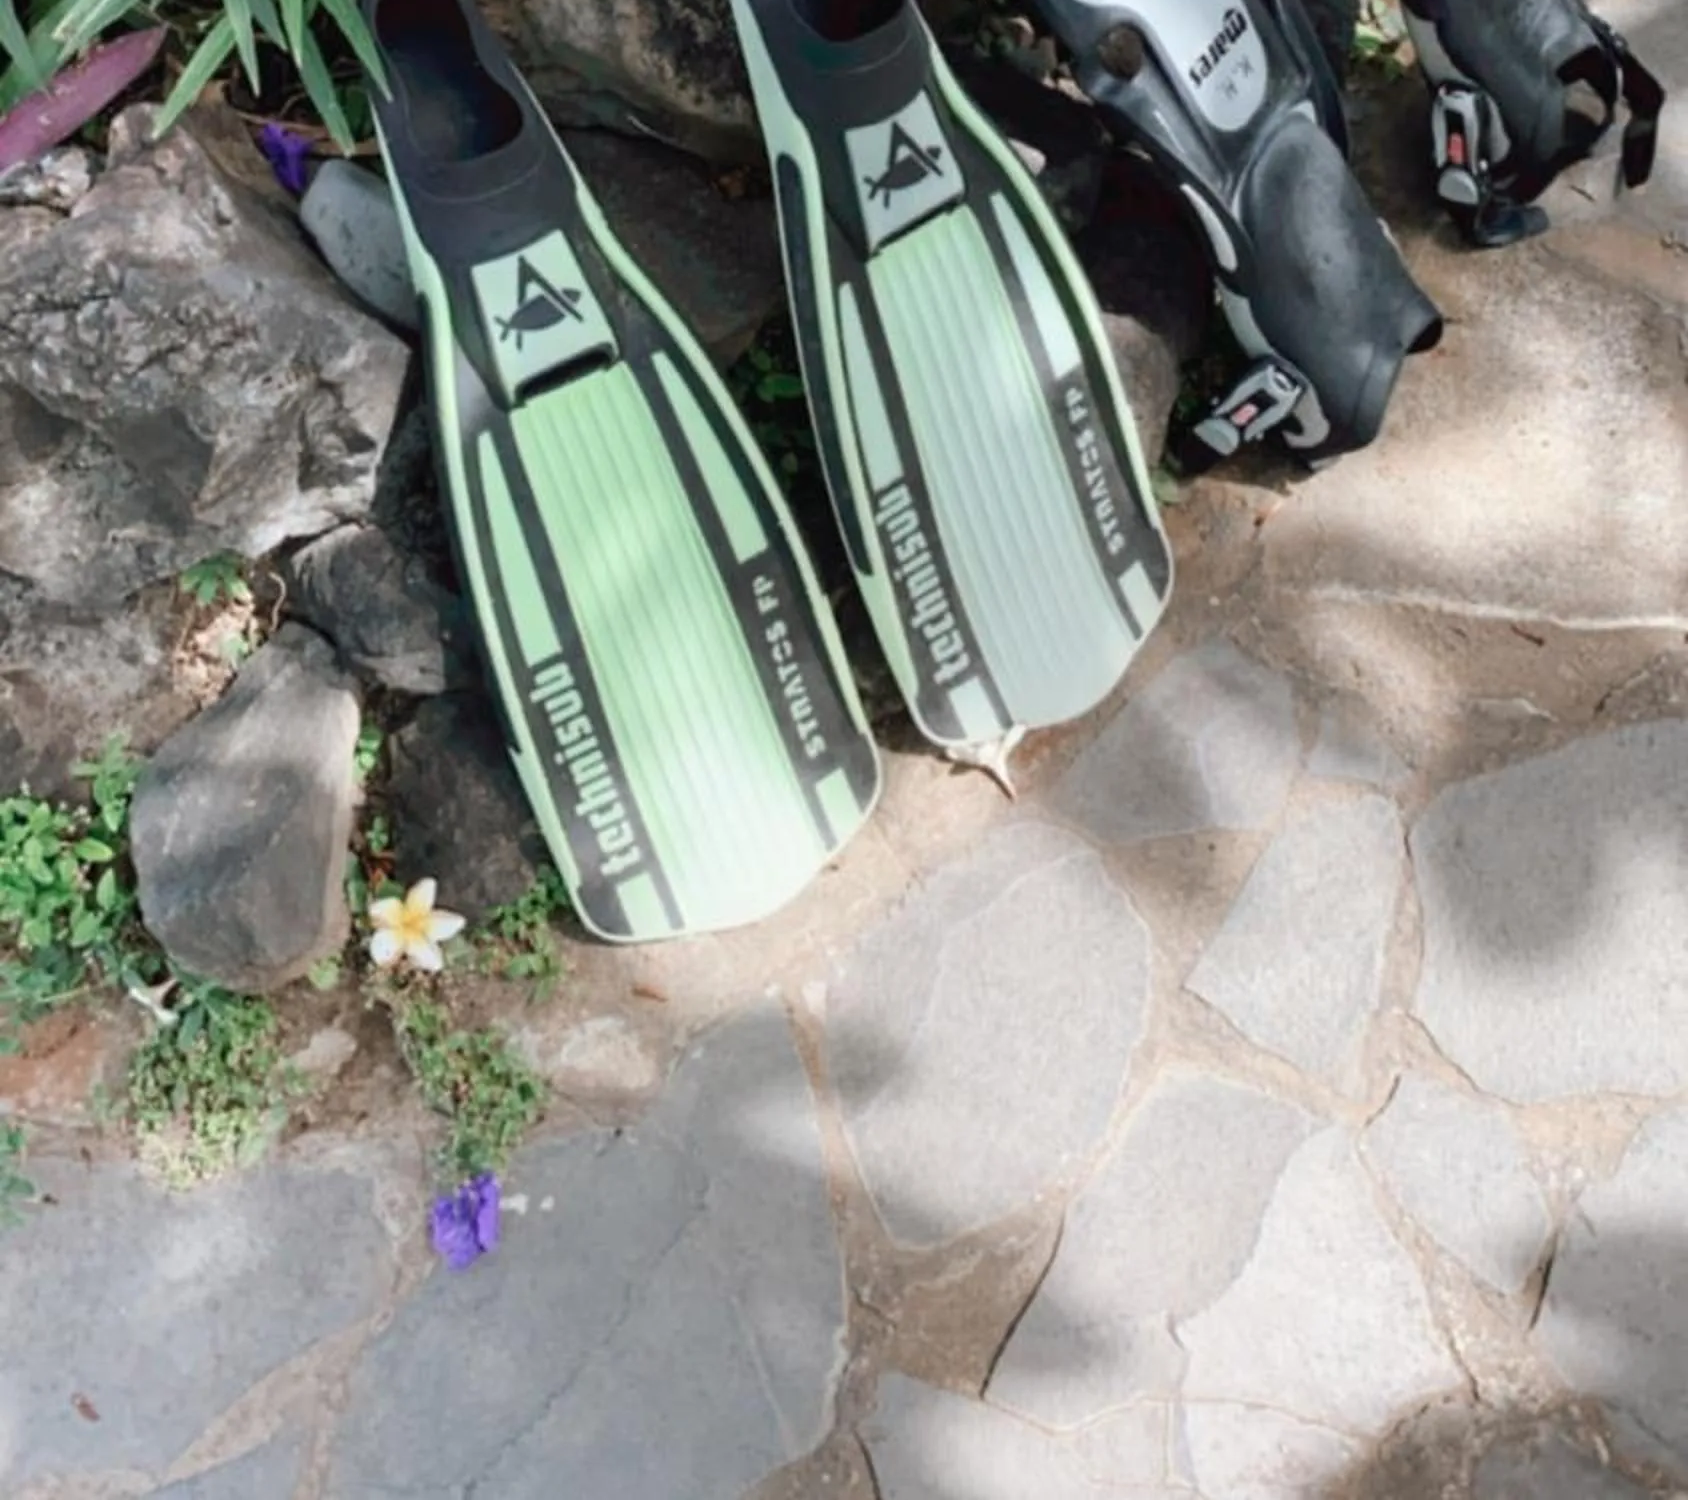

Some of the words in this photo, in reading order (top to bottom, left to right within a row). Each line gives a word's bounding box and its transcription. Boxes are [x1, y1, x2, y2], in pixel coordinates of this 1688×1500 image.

[1188, 7, 1247, 88] mares
[1065, 386, 1090, 423] FP
[1073, 426, 1125, 555] STRATOS
[752, 574, 780, 614] FP
[875, 483, 970, 684] technisub
[765, 620, 827, 759] STRATOS
[529, 661, 643, 876] technisub
